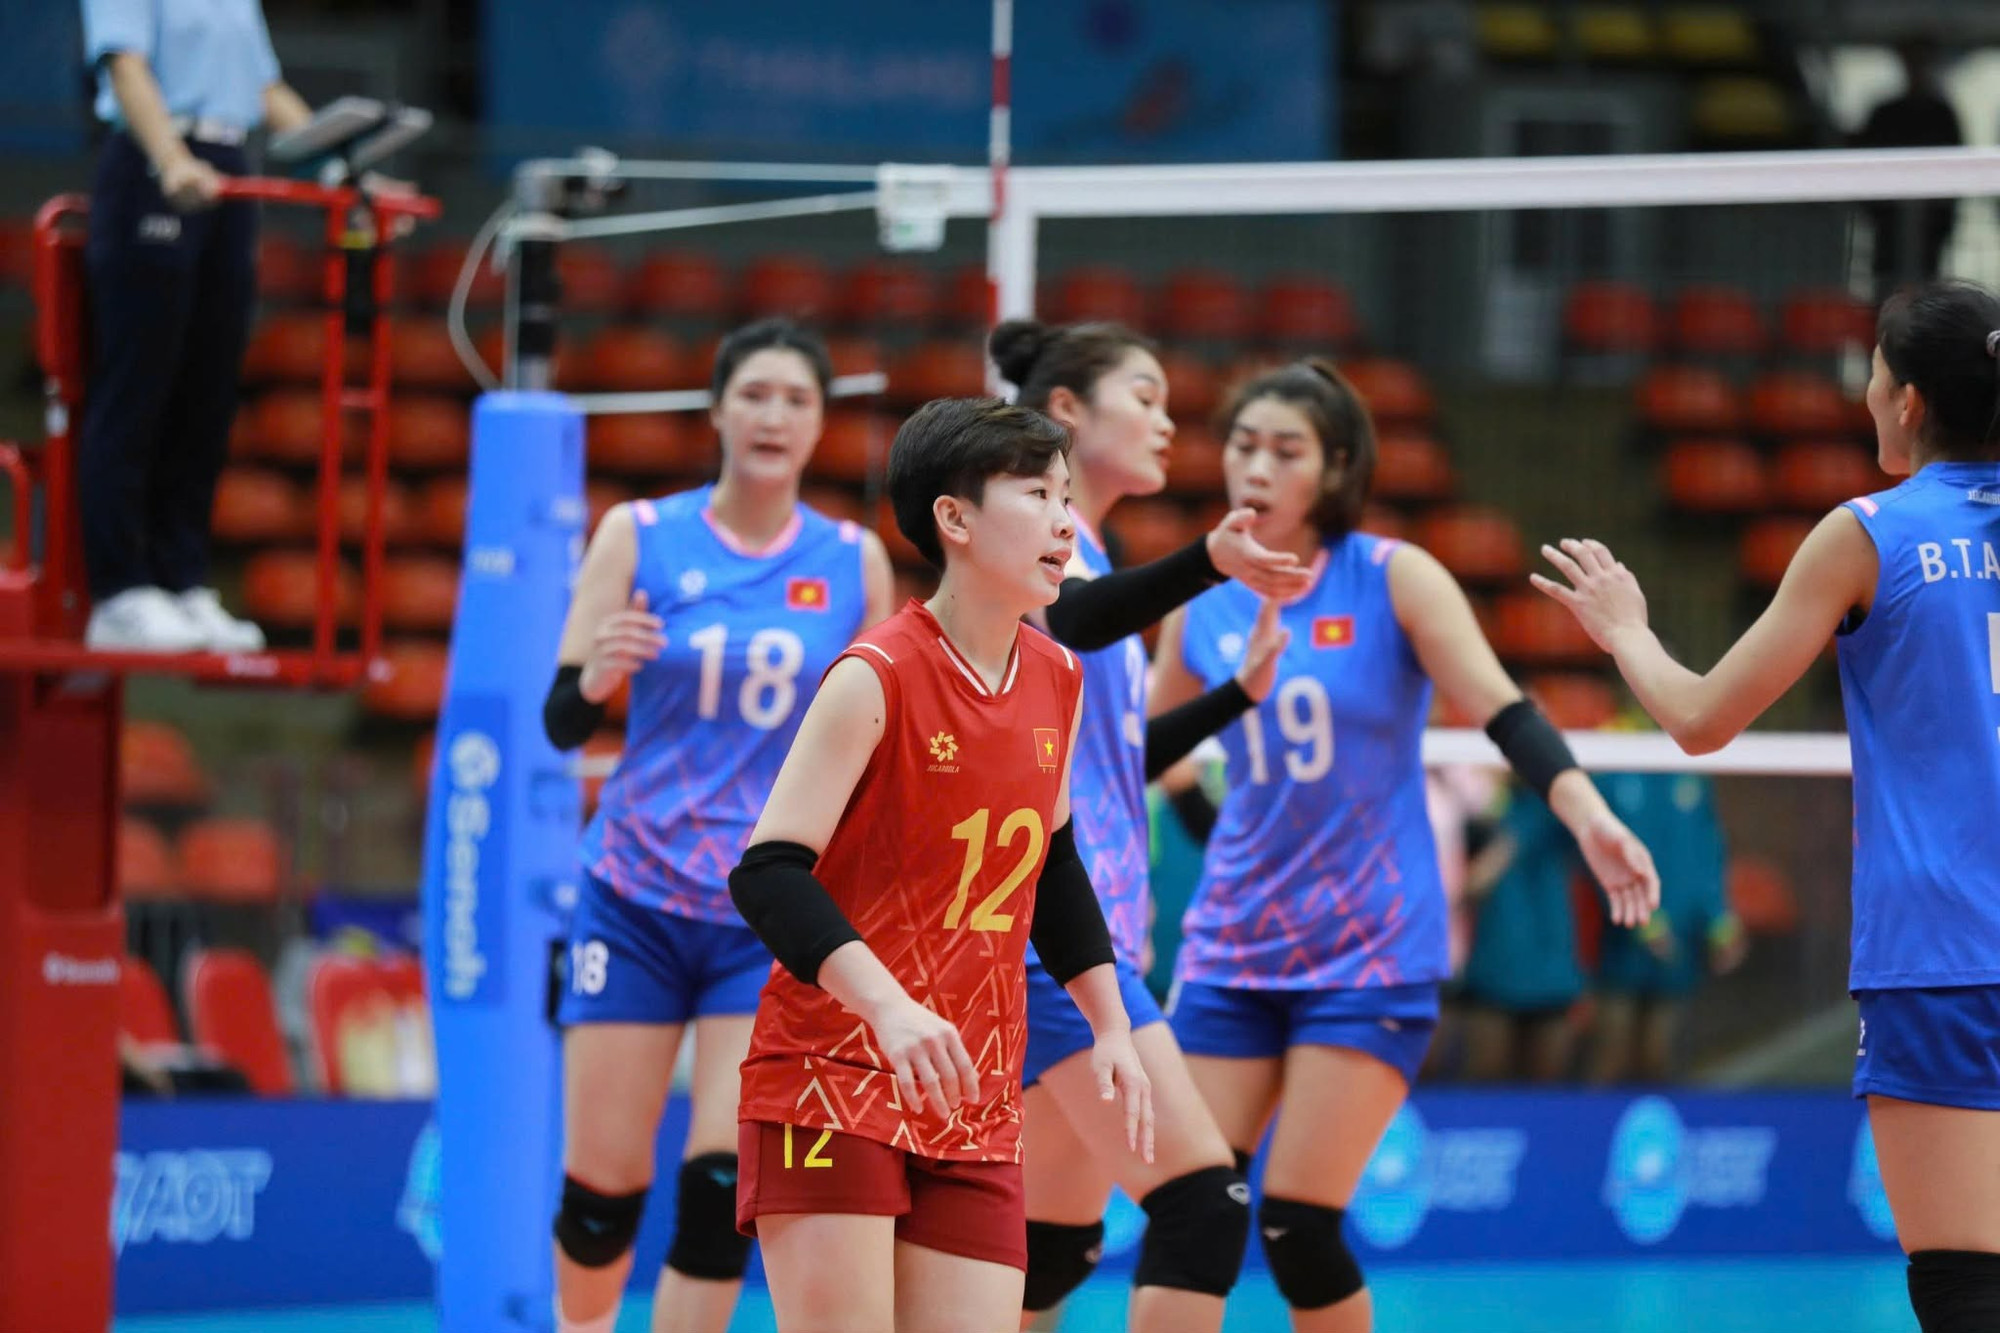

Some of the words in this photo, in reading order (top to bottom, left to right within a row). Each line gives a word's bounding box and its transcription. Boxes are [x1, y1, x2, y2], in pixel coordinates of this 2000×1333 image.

[688, 623, 806, 731] 18
[1242, 675, 1335, 785] 19
[943, 807, 1045, 933] 12
[571, 939, 610, 995] 18
[784, 1122, 834, 1169] 12
